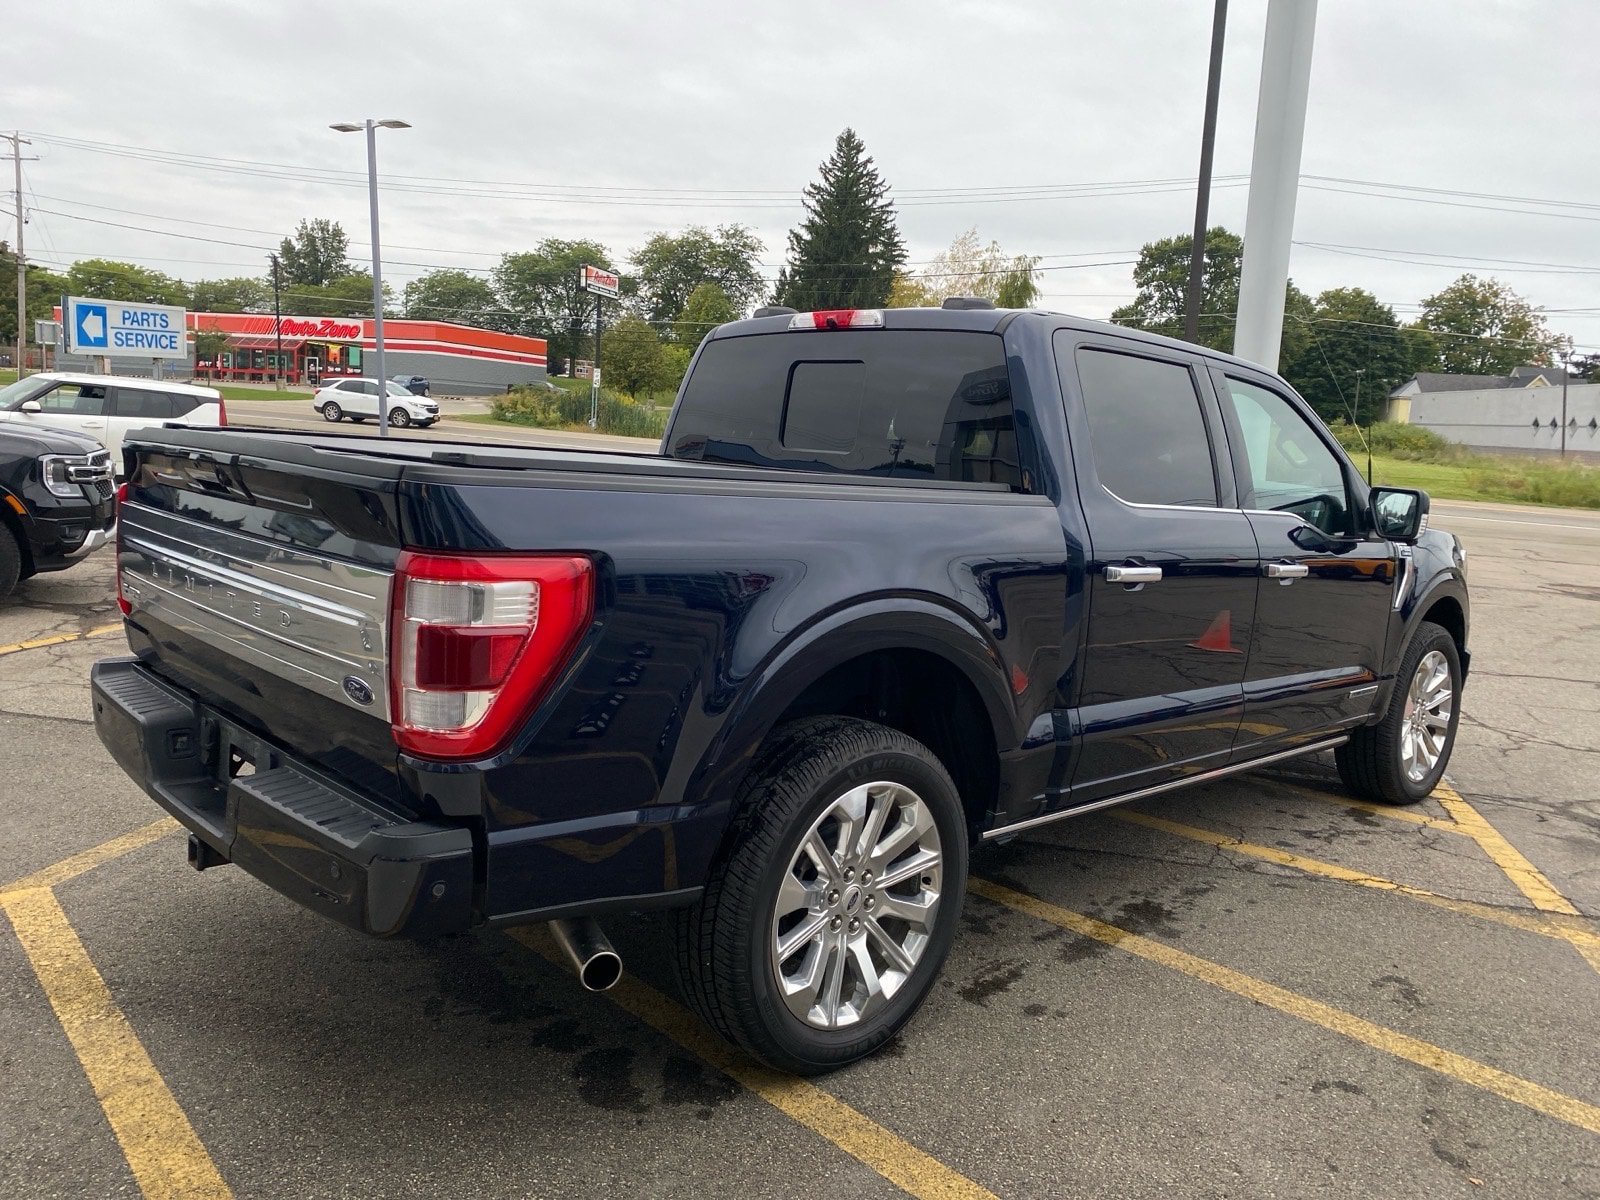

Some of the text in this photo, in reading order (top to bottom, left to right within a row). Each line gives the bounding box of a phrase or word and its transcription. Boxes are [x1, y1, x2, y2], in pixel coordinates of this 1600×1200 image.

[122, 310, 169, 329] PARTS
[280, 318, 361, 339] AutoZone
[114, 331, 178, 350] SERVICE
[151, 560, 293, 629] LIMITED
